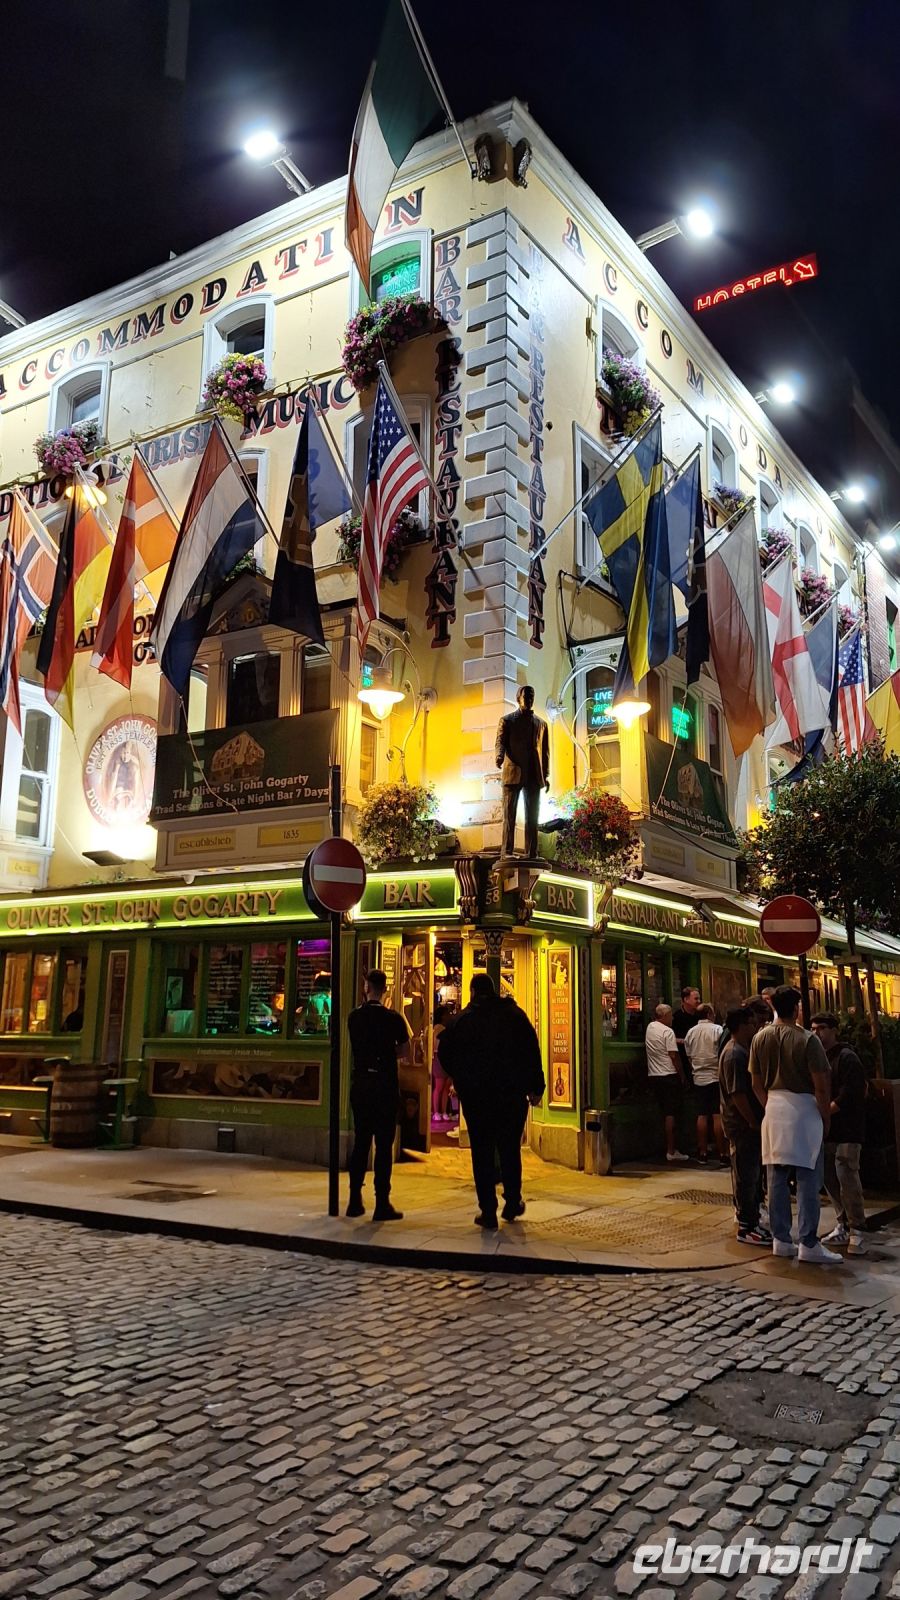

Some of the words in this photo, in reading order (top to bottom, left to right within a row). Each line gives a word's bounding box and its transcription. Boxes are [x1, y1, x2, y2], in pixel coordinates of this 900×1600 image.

[0, 186, 426, 400] CCOMMODATIN
[435, 236, 462, 327] BAR
[424, 337, 463, 648] RESTAURANT
[528, 344, 547, 649] RESTAURANT
[595, 690, 613, 700] LIVE
[155, 803, 174, 815] Trad
[175, 800, 213, 813] Sessions
[247, 792, 275, 806] Night
[277, 790, 294, 801] Bar
[295, 789, 302, 798] 7
[304, 786, 330, 798] Days
[173, 789, 190, 799] The
[192, 784, 220, 798] Oliver
[223, 783, 237, 794] St.
[239, 780, 264, 794] John
[266, 775, 309, 789] Gogarty
[383, 879, 437, 909] BAR
[485, 889, 500, 905] 58
[547, 885, 577, 912] BAR
[7, 905, 71, 930] OLIVER
[111, 898, 161, 924] JOHN
[172, 890, 283, 921] GOGARTY
[611, 896, 680, 932] RESTAURANT
[714, 922, 750, 945] OLIVER
[553, 1046, 569, 1054] MUSIC
